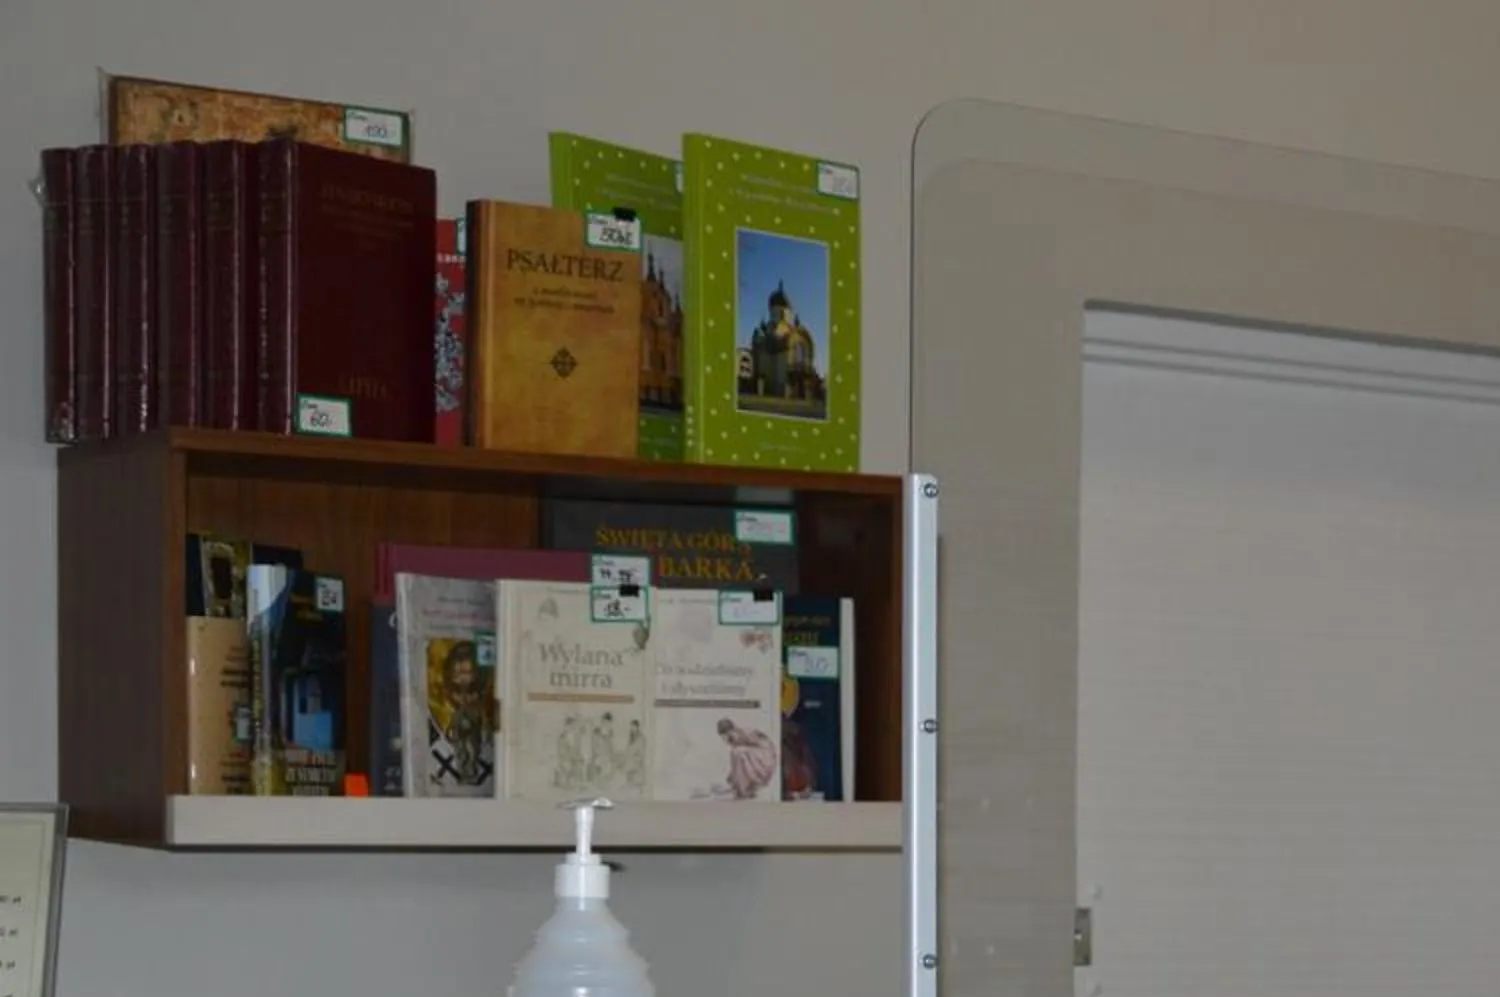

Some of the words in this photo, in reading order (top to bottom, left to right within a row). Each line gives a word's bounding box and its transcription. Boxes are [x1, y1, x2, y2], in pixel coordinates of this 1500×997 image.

[507, 248, 625, 282] PSAŁTERZ
[540, 640, 624, 668] Wylana
[550, 668, 613, 689] mirra
